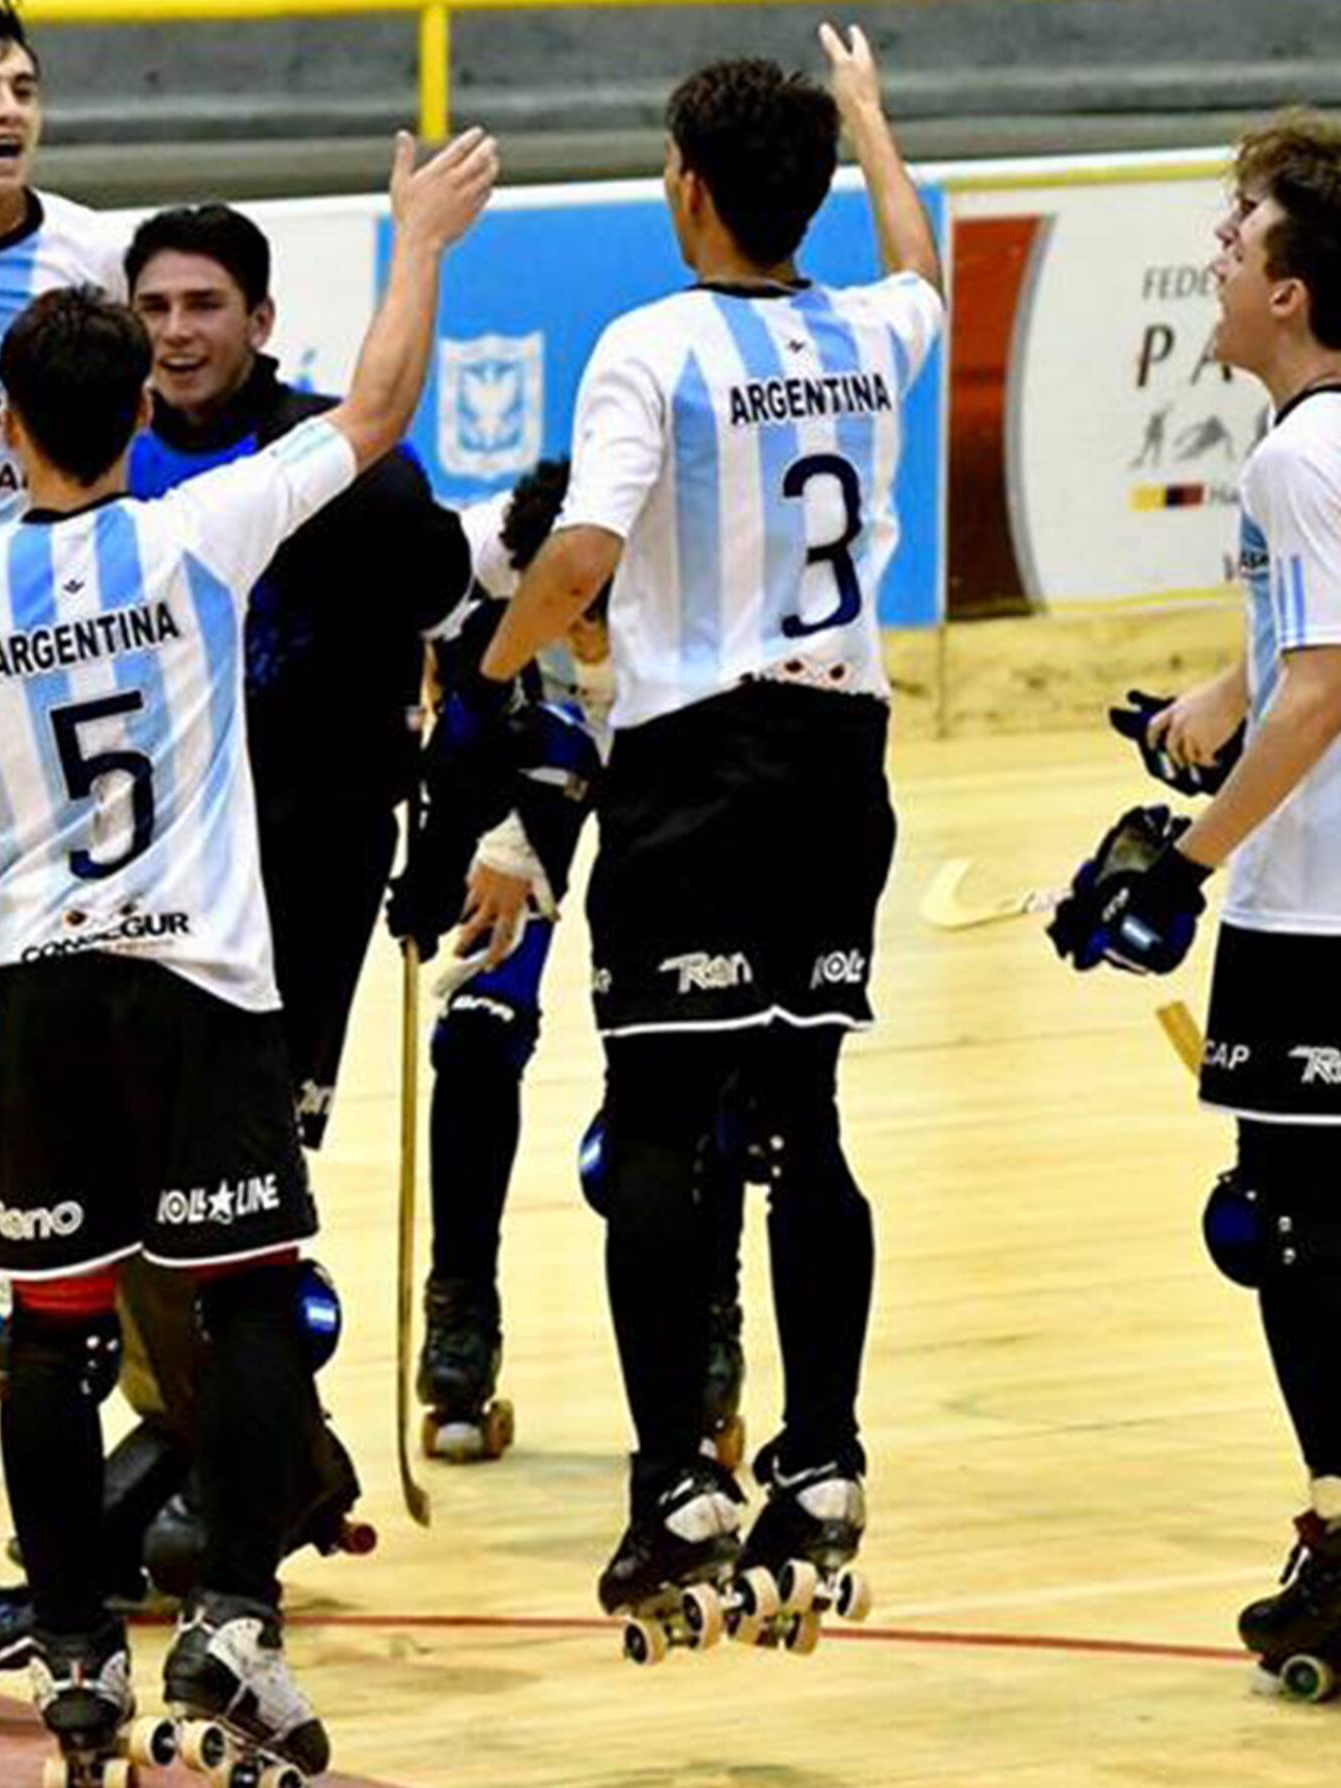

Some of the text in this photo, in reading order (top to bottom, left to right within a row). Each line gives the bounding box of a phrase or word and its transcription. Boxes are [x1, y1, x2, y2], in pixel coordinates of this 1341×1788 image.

[729, 373, 892, 426] ARGENTINA
[781, 453, 864, 639] 3
[49, 689, 156, 880] 5
[235, 1172, 281, 1217] LINE
